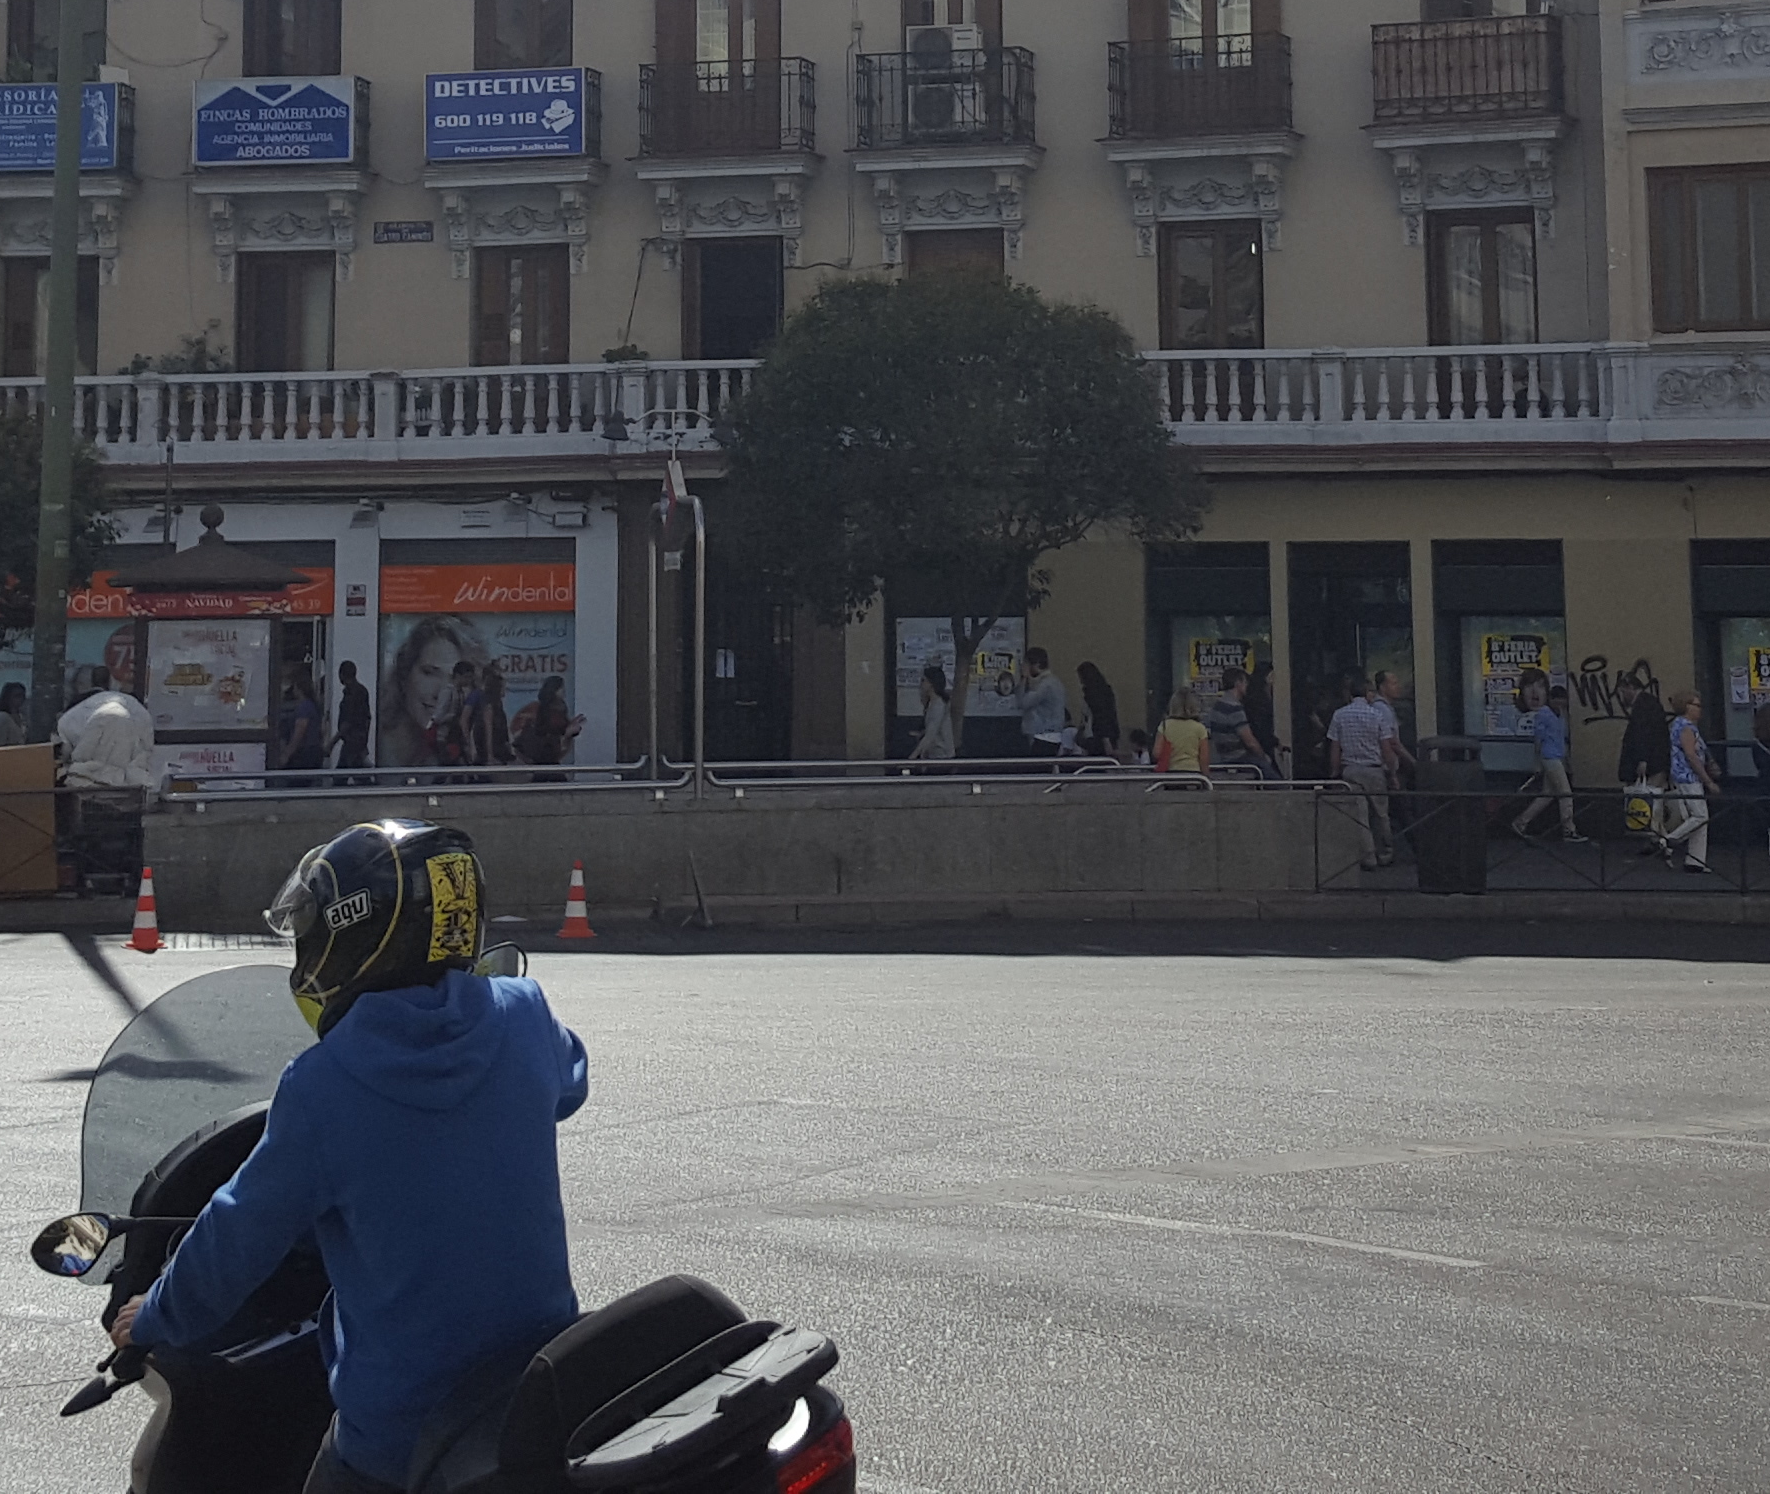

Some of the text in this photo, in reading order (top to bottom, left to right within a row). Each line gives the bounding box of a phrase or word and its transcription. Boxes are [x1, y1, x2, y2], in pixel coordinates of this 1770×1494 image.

[434, 75, 576, 98] DETECTIVES
[200, 106, 346, 122] FINCAS HOMBRADOS
[434, 112, 537, 128] 600 119 118
[235, 121, 312, 132] COMUNIDADES
[212, 132, 333, 144] AGENCIA INMOBILIARIA
[236, 145, 310, 157] ABOGADOS
[454, 142, 569, 154] Peritaciones Judiciales
[185, 598, 234, 609] NAVIDAD
[499, 653, 568, 673] GRATIS
[1199, 655, 1244, 666] OUTLET
[1491, 652, 1538, 663] OUTLET
